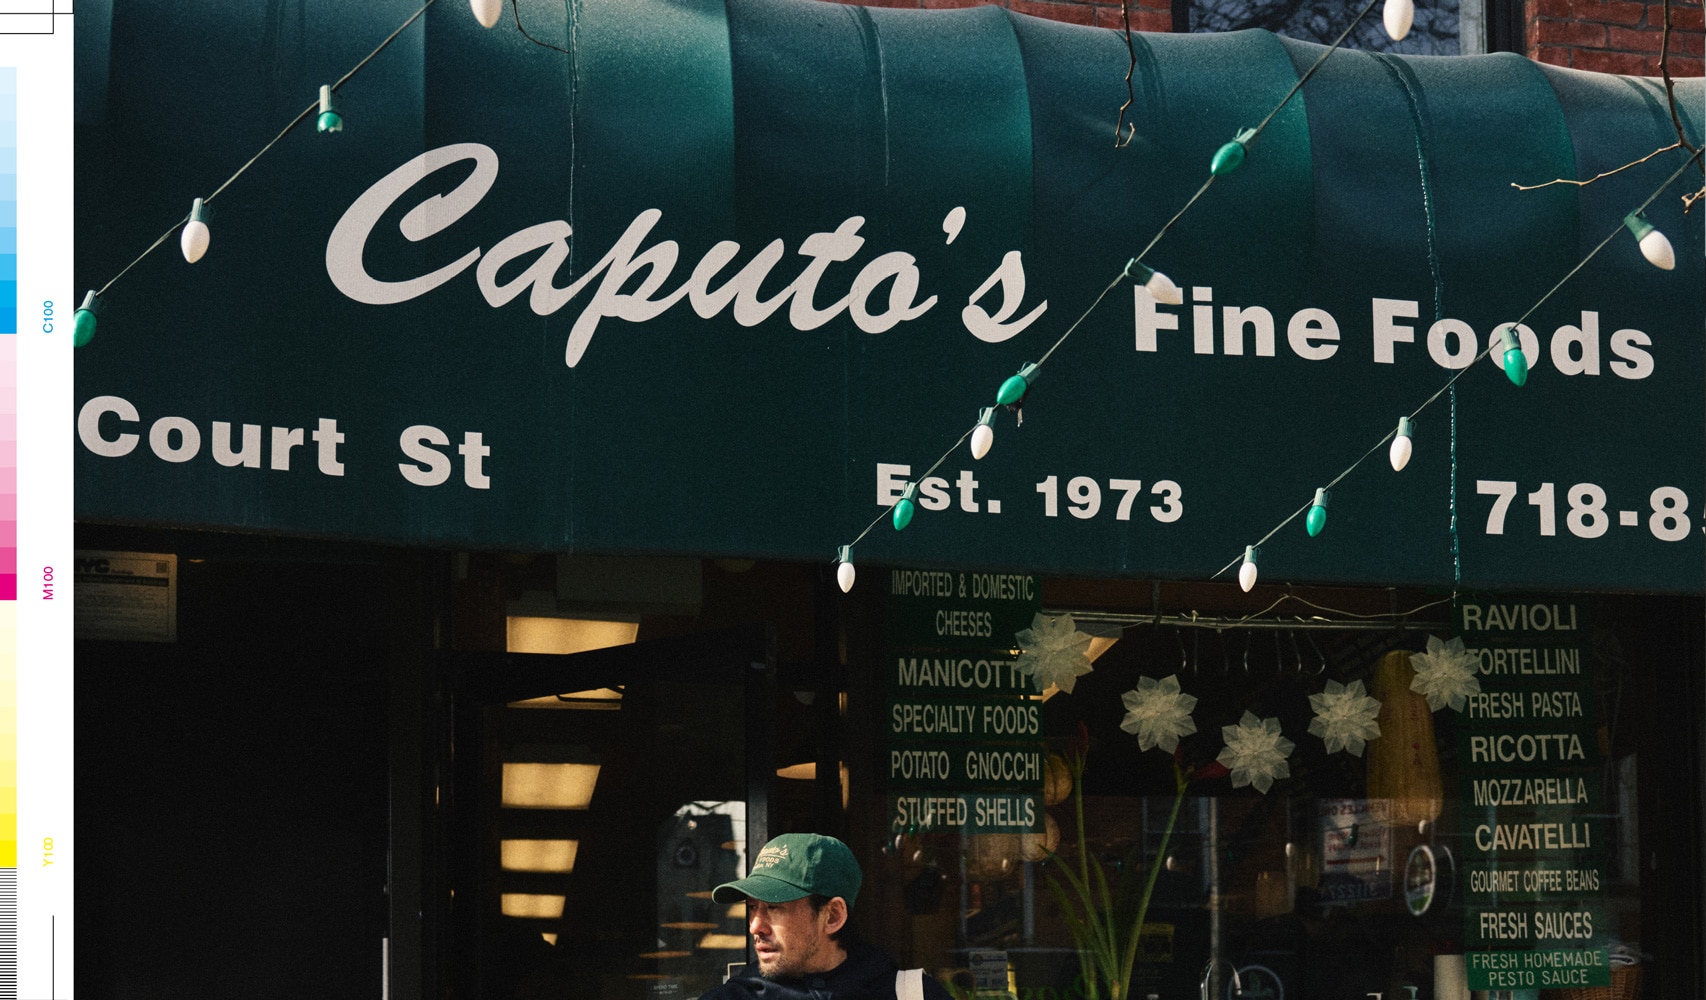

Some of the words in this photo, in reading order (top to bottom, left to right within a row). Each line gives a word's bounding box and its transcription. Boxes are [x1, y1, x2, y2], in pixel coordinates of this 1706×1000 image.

[325, 142, 1048, 369] Caputo’s
[1134, 284, 1341, 360] Fine
[1372, 297, 1655, 381] Foods
[77, 395, 346, 477] Court
[398, 425, 491, 490] St
[876, 463, 1001, 515] Est.
[1036, 475, 1184, 523] 1973
[1476, 480, 1706, 542] 718-8
[891, 570, 953, 599] IMPORTED
[959, 574, 968, 598] &
[972, 572, 1034, 602] DOMESTIC
[935, 609, 992, 638] CHEESES
[1462, 603, 1578, 632] RAVIOLI
[898, 657, 1026, 689] MANICOTTI
[892, 704, 976, 734] SPECIALTY
[983, 705, 1039, 735] FOODS
[1468, 691, 1525, 719] FRESH
[1531, 690, 1583, 718] PASTA
[1470, 733, 1585, 763] RICOTTA
[891, 750, 950, 780] POTATO
[965, 751, 1040, 781] GNOCCHI
[1473, 778, 1588, 806] MOZZARELLA
[896, 796, 968, 827] STUFFED
[975, 797, 1036, 827] SHELLS
[1475, 823, 1590, 851] CAVATELLI
[1470, 869, 1520, 893] GOURMET
[1523, 869, 1562, 892] COFFEE
[1566, 869, 1599, 891] BEANS
[1480, 911, 1528, 940] FRESH
[1534, 911, 1593, 940] SAUCES
[1472, 953, 1520, 969] FRESH
[1524, 950, 1602, 968] HOMEMADE
[1489, 970, 1535, 987] PESTO
[1542, 968, 1589, 985] SAUCE
